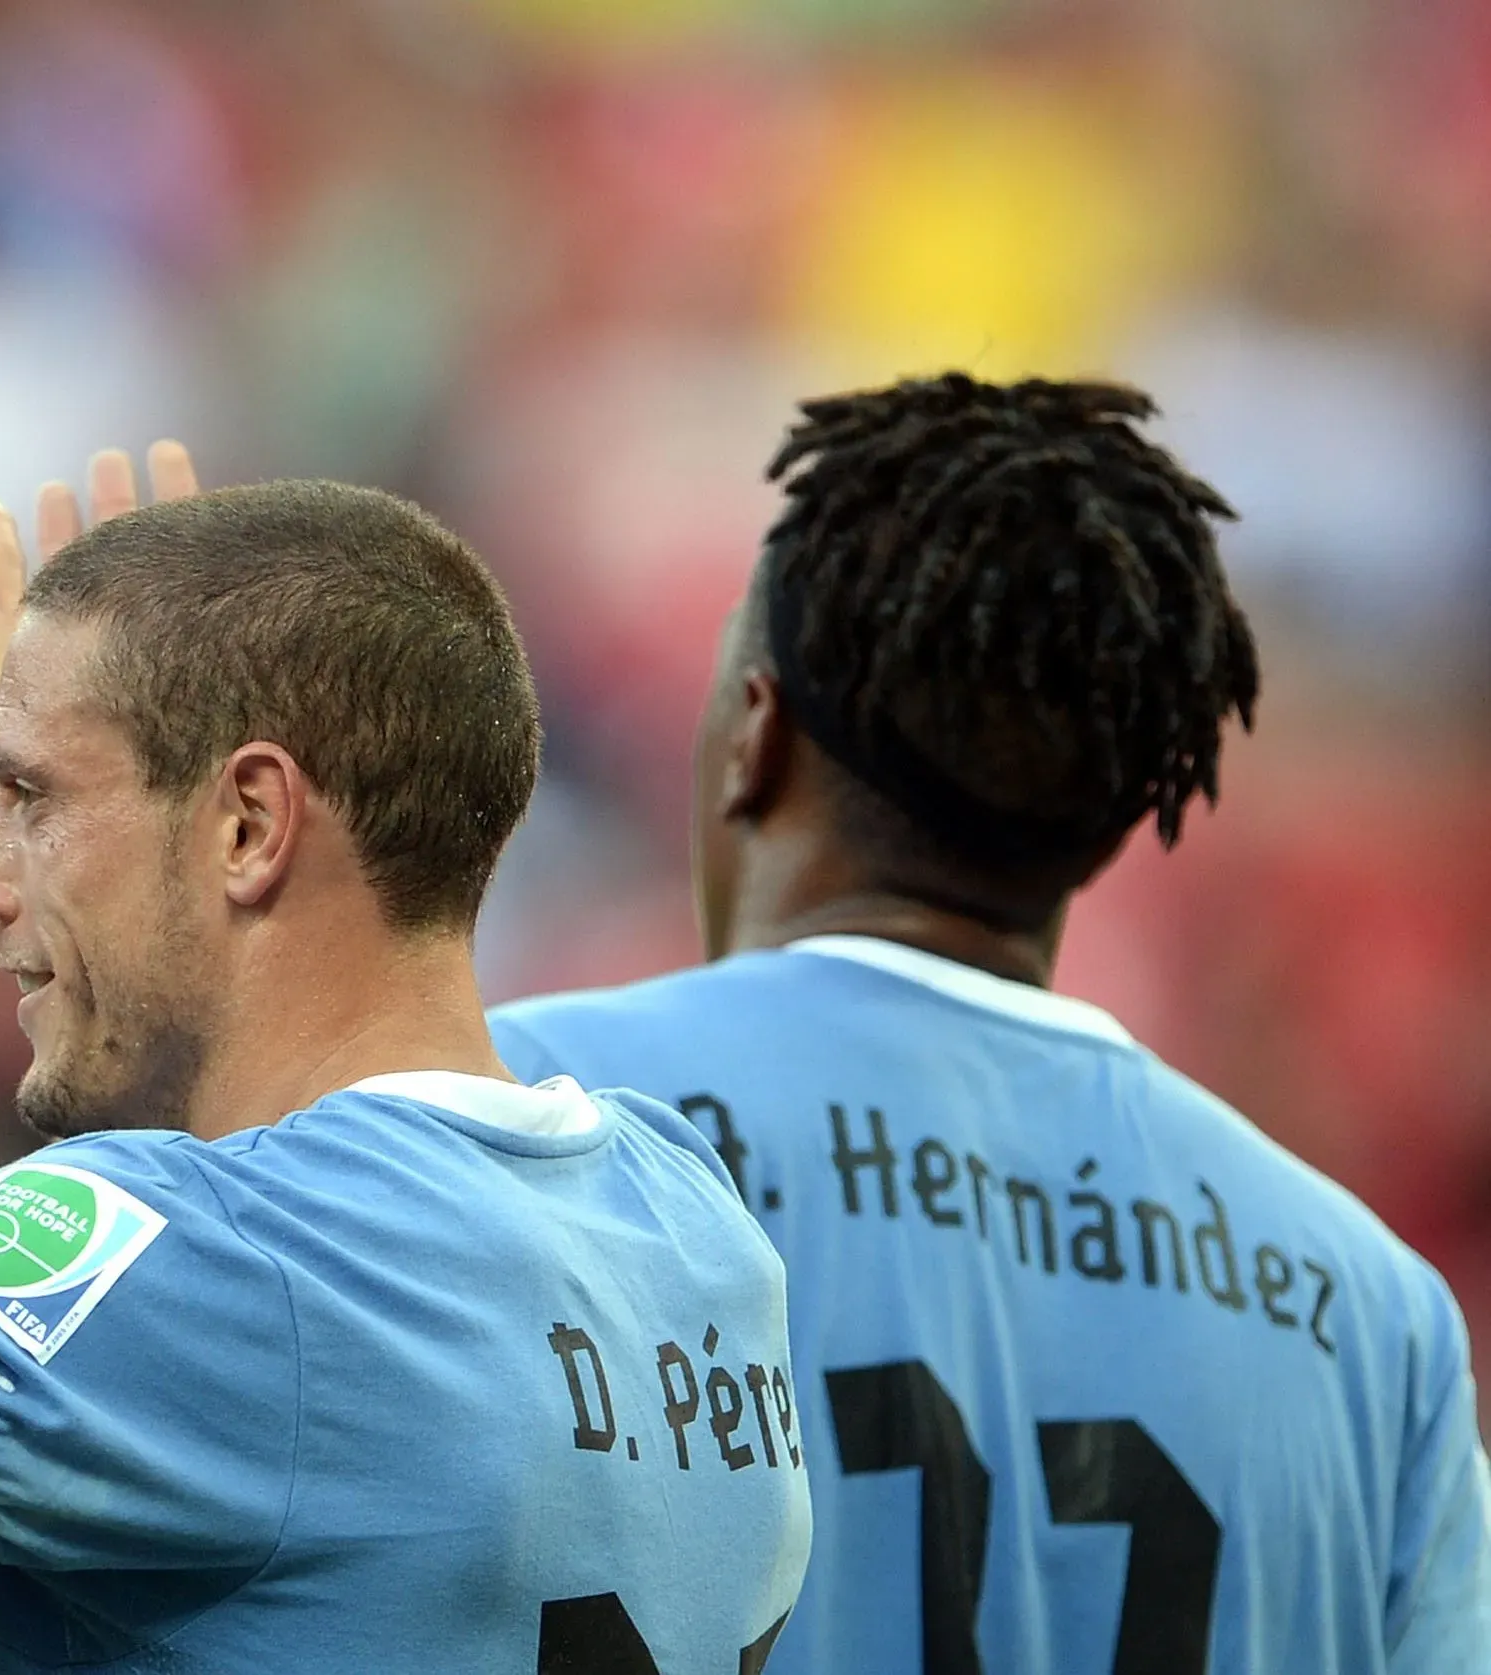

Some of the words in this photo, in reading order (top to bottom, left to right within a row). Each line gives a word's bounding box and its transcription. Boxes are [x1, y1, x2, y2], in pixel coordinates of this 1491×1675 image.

[23, 1204, 79, 1243] HOPE
[826, 1103, 1336, 1356] Hernández
[4, 1299, 48, 1343] FIFA
[546, 1322, 640, 1462] D.
